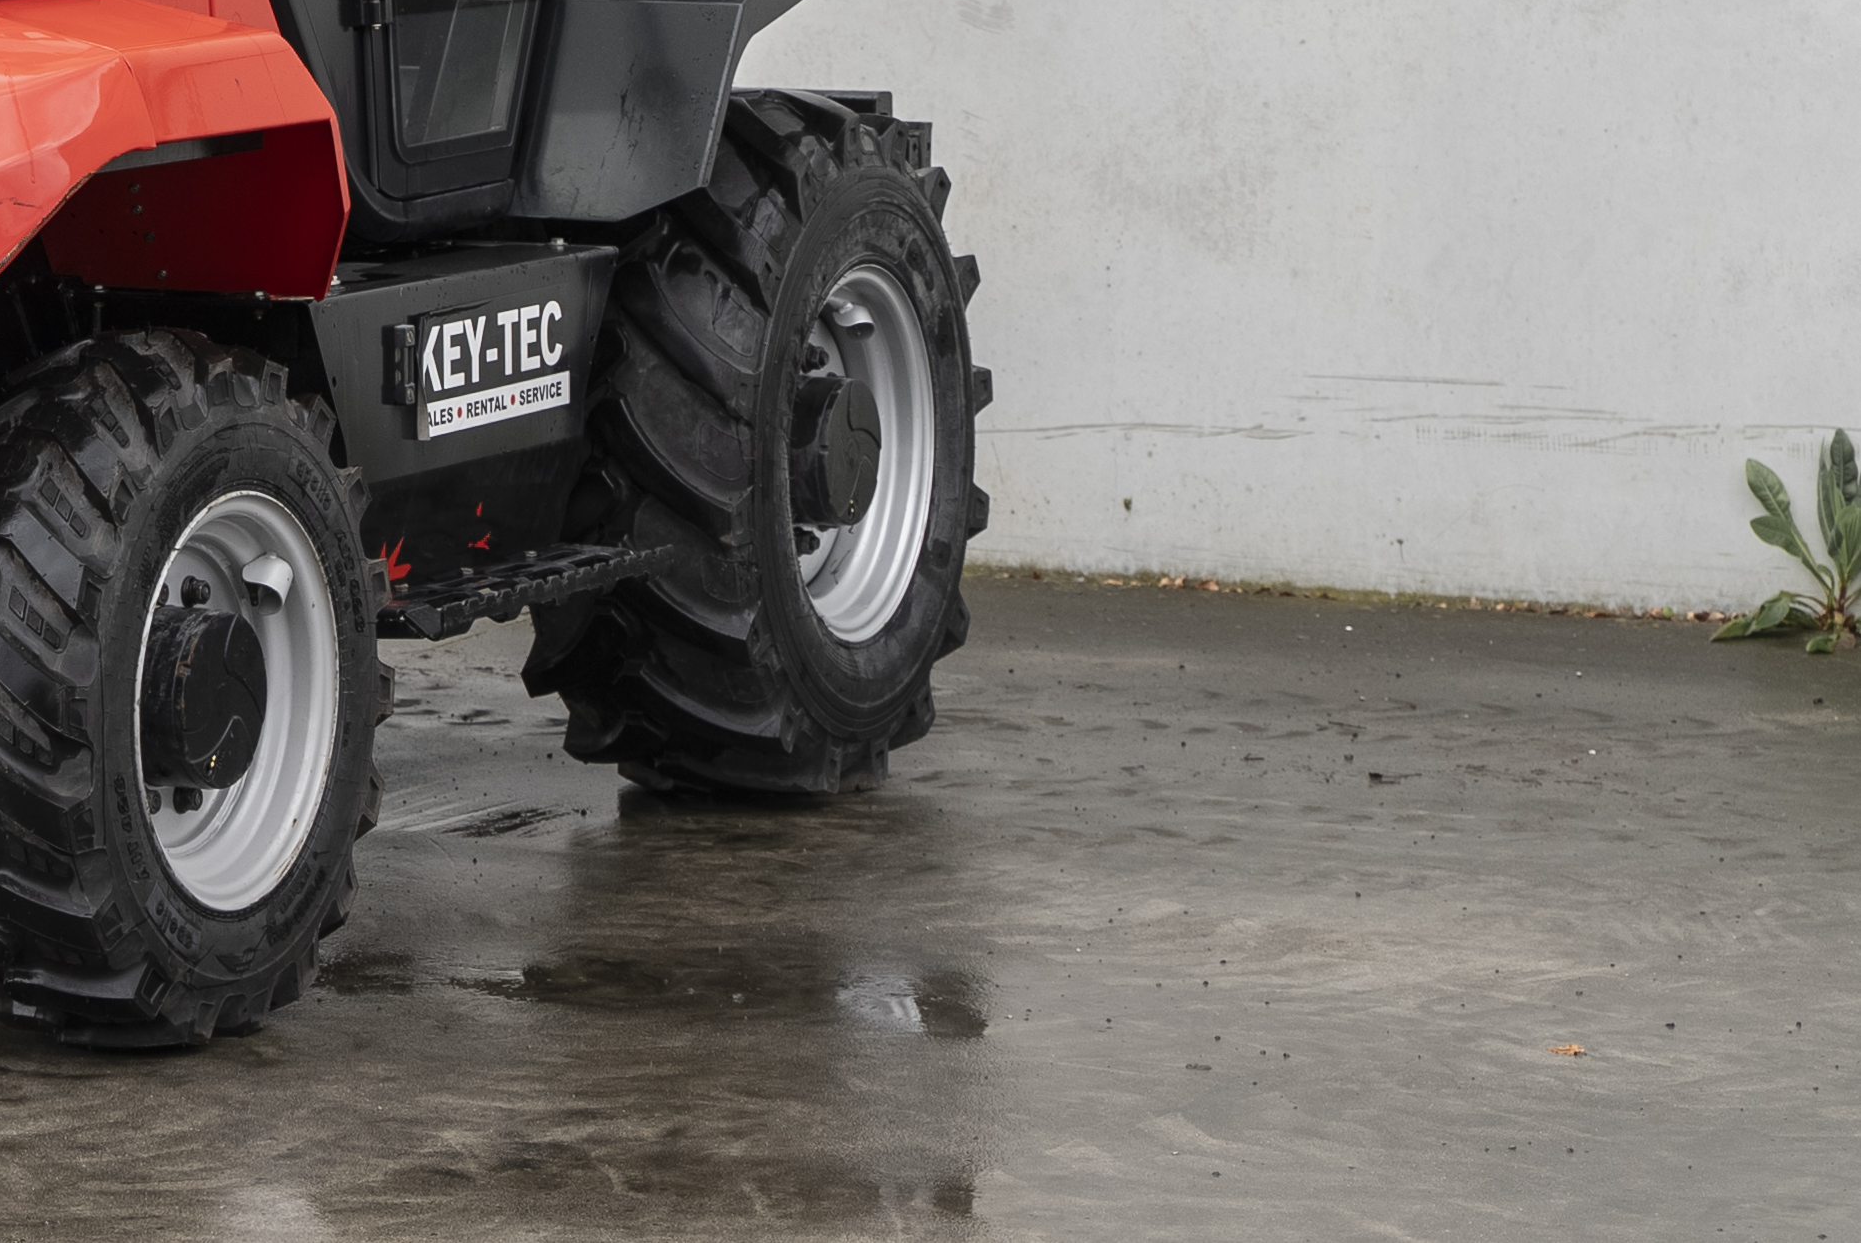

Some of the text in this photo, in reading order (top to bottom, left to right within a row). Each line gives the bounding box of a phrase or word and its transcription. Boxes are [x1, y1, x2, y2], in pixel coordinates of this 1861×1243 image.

[423, 300, 563, 392] KEY-TEC
[466, 395, 507, 419] RENTAL
[519, 381, 562, 406] SERVICE
